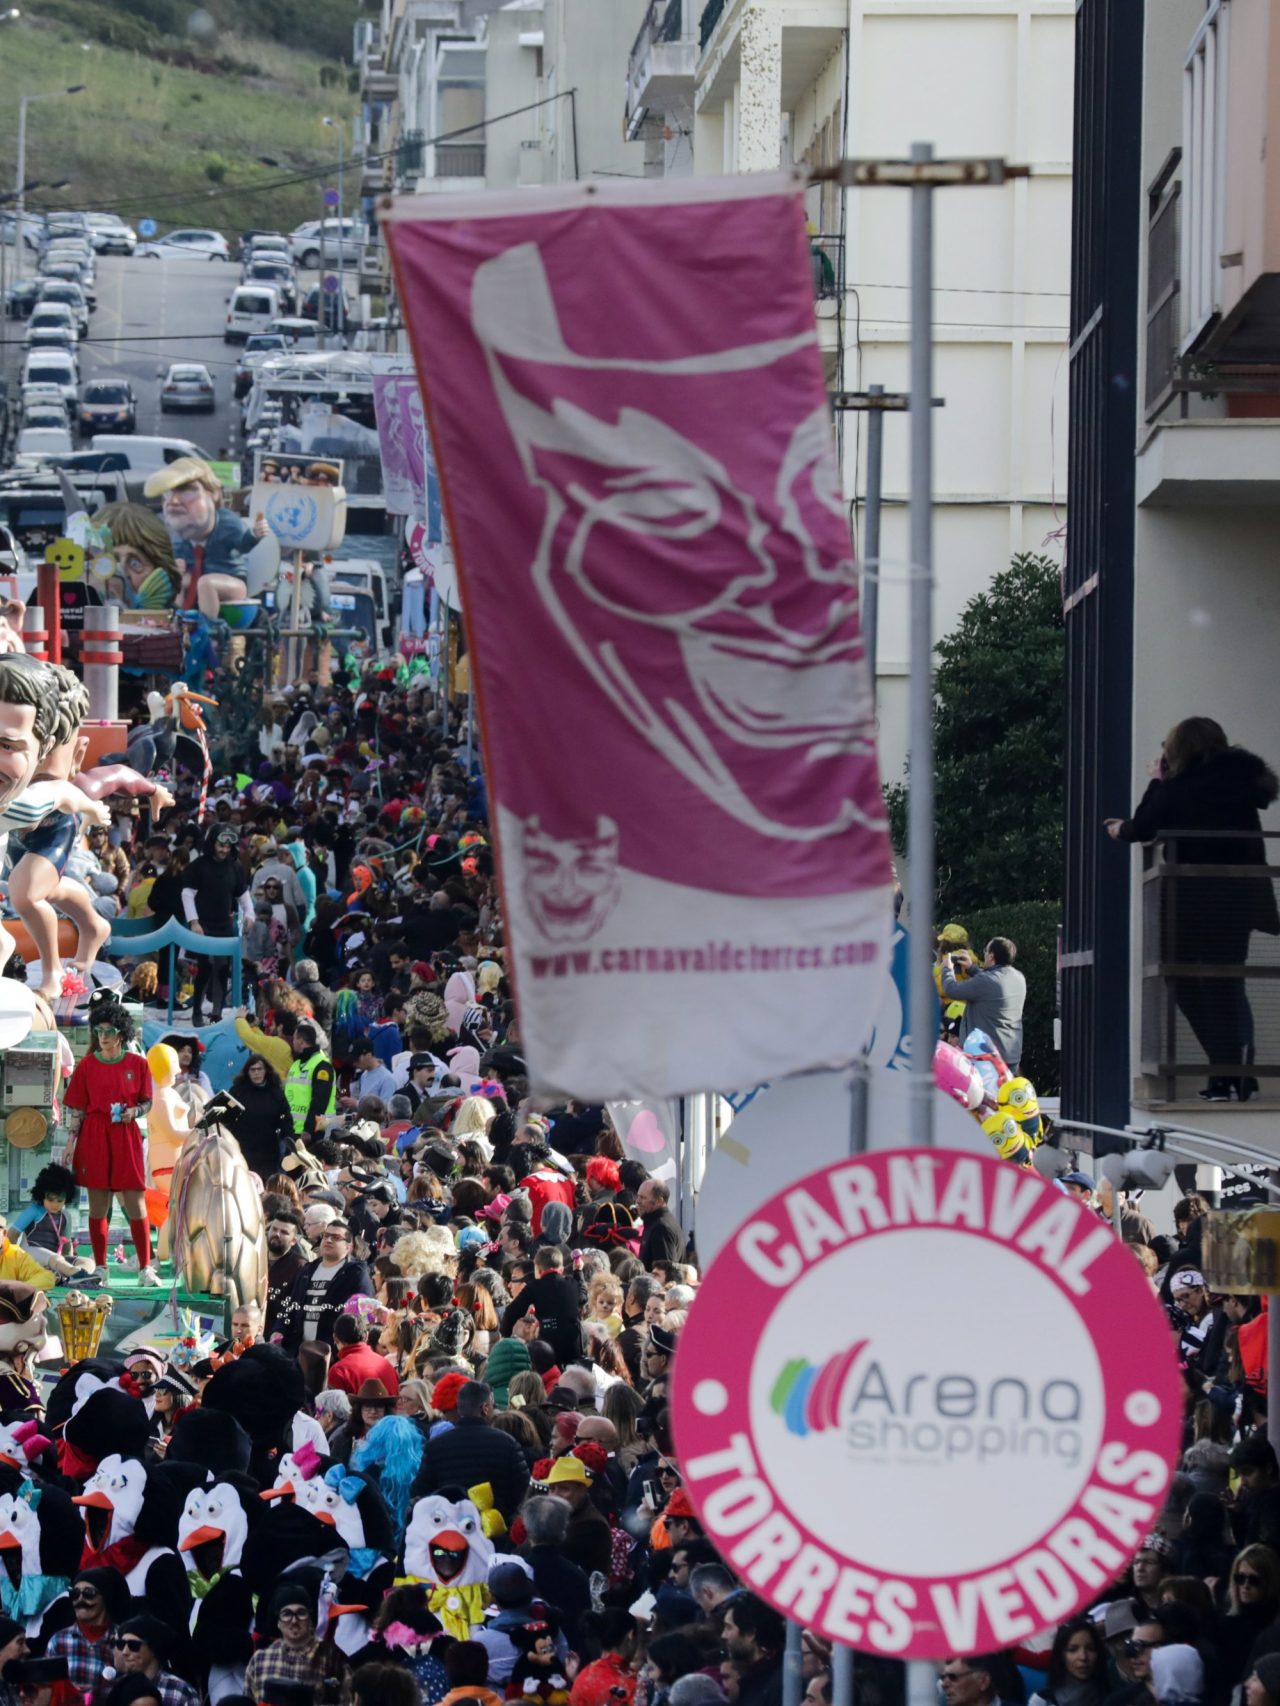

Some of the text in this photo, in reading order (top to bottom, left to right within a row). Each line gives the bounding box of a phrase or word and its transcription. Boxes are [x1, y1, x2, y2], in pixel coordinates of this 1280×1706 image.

[736, 1153, 1115, 1296] CARNAVAL
[847, 1417, 1083, 1469] shopping
[850, 1360, 1082, 1423] Arena
[685, 1432, 1170, 1653] TORRES VEDRAS
